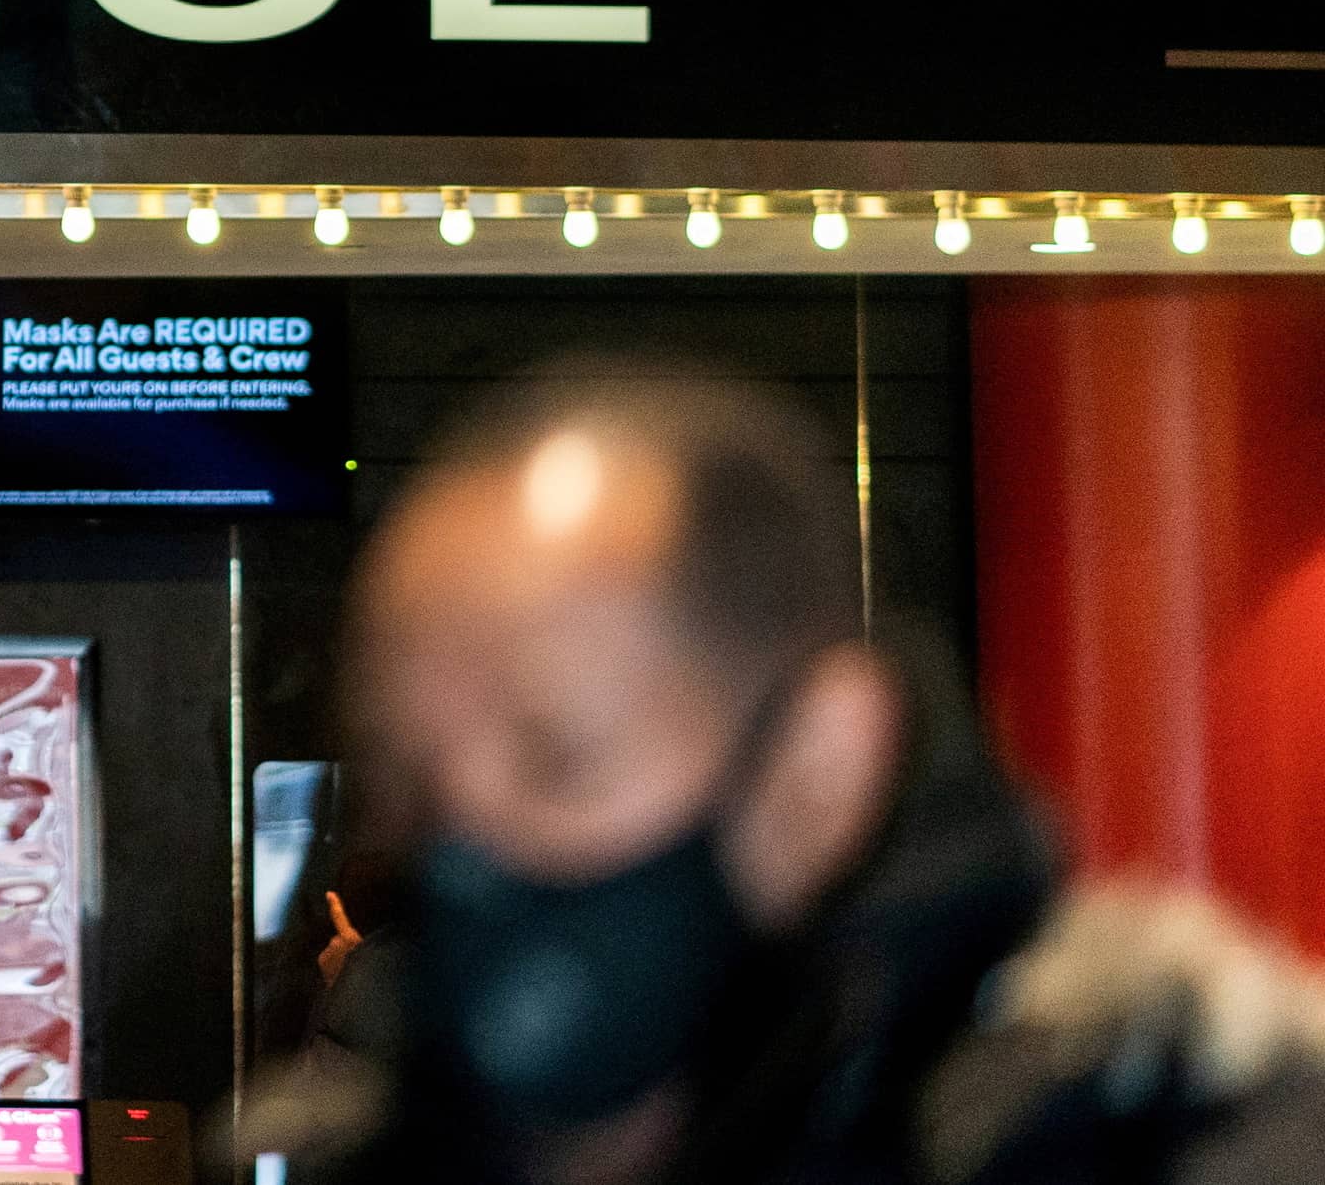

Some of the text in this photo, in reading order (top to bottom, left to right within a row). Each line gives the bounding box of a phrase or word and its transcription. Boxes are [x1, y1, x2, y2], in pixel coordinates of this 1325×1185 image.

[3, 317, 312, 345] Masks Are REQUIRED
[3, 346, 310, 372] For All Guests & Crew
[3, 381, 58, 396] PLEASE
[59, 381, 89, 396] PUT
[91, 381, 141, 396] YOURS
[144, 381, 168, 396] ON
[170, 381, 229, 396] BEFORE
[3, 397, 46, 411] Masks
[48, 399, 70, 411] are
[72, 397, 132, 411] available
[134, 397, 151, 411] for
[154, 397, 217, 413] purchase
[219, 397, 229, 411] if
